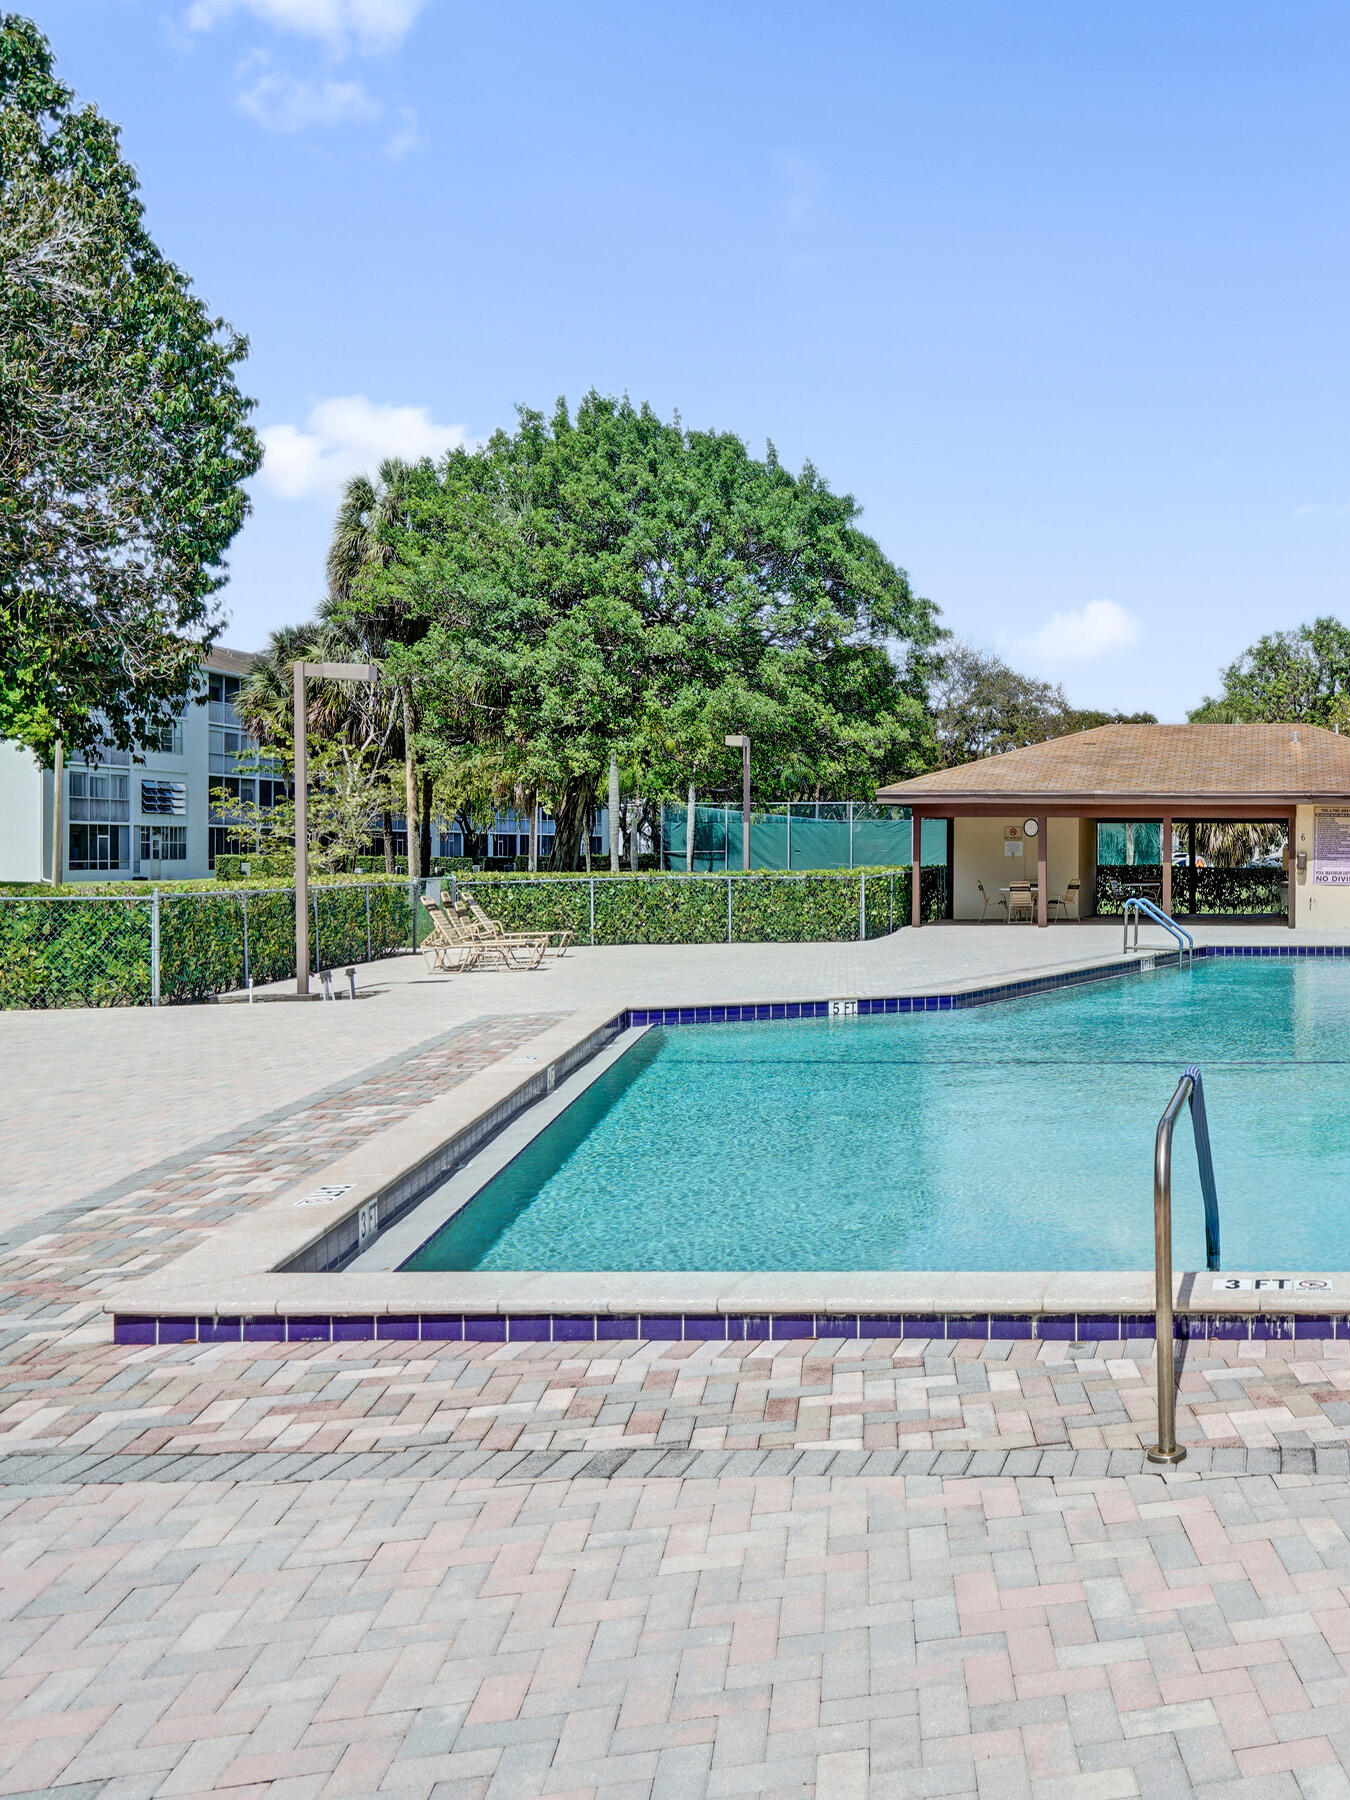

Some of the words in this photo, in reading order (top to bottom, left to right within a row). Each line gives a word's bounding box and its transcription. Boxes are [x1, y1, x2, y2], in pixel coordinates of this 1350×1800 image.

[833, 1002, 840, 1014] 5
[361, 1210, 366, 1238] 3
[1224, 1280, 1240, 1289] 3
[1255, 1279, 1292, 1289] FT
